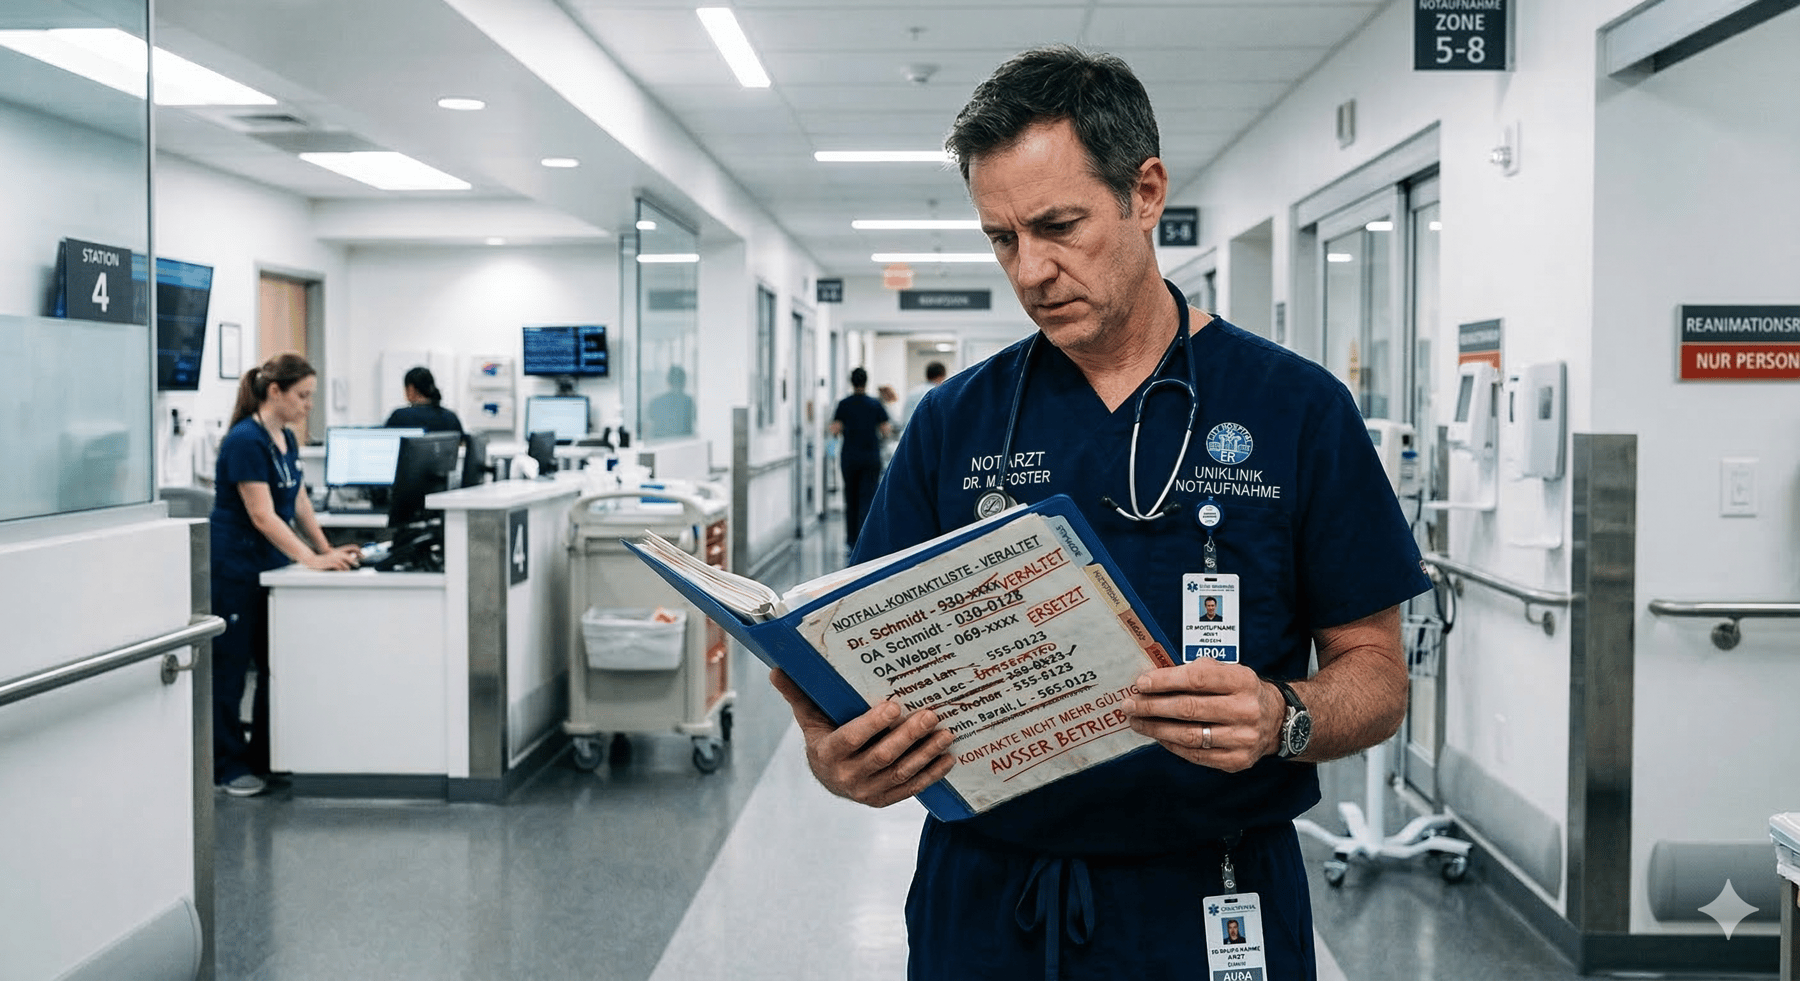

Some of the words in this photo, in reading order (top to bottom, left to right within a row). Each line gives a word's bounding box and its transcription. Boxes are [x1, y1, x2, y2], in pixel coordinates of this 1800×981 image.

[1419, 0, 1500, 10] NOTAUFNAHME
[1435, 14, 1485, 31] ZONE
[1435, 36, 1485, 64] 5-8
[82, 248, 120, 267] STATION
[91, 272, 110, 313] 4
[1686, 317, 1800, 332] REANIMATIONSR
[1696, 352, 1731, 369] NUR
[1736, 352, 1800, 369] PERSON
[1220, 451, 1236, 463] ER
[963, 476, 982, 490] DR.
[1195, 466, 1263, 482] UNIKLINIK
[1175, 479, 1281, 499] NOTAUFNAHME
[512, 523, 526, 573] 4
[832, 565, 973, 632] NOTFALL-KONTAKTLISTE
[979, 534, 1041, 568] VERALTET
[998, 547, 1066, 591] VERALTET
[1027, 586, 1085, 624] ERSETZT
[847, 635, 869, 652] Dr.
[869, 608, 928, 641] Schmidt
[860, 648, 885, 664] OA
[885, 622, 944, 654] Schmidt
[895, 643, 942, 669] Weber
[985, 630, 1048, 661] 555-0123
[957, 731, 1022, 766] KONTAKTE
[1021, 716, 1058, 741] NICHT
[1058, 703, 1096, 725] MEHR
[990, 738, 1054, 775] AUSSER
[1053, 708, 1128, 748] BETRIEB
